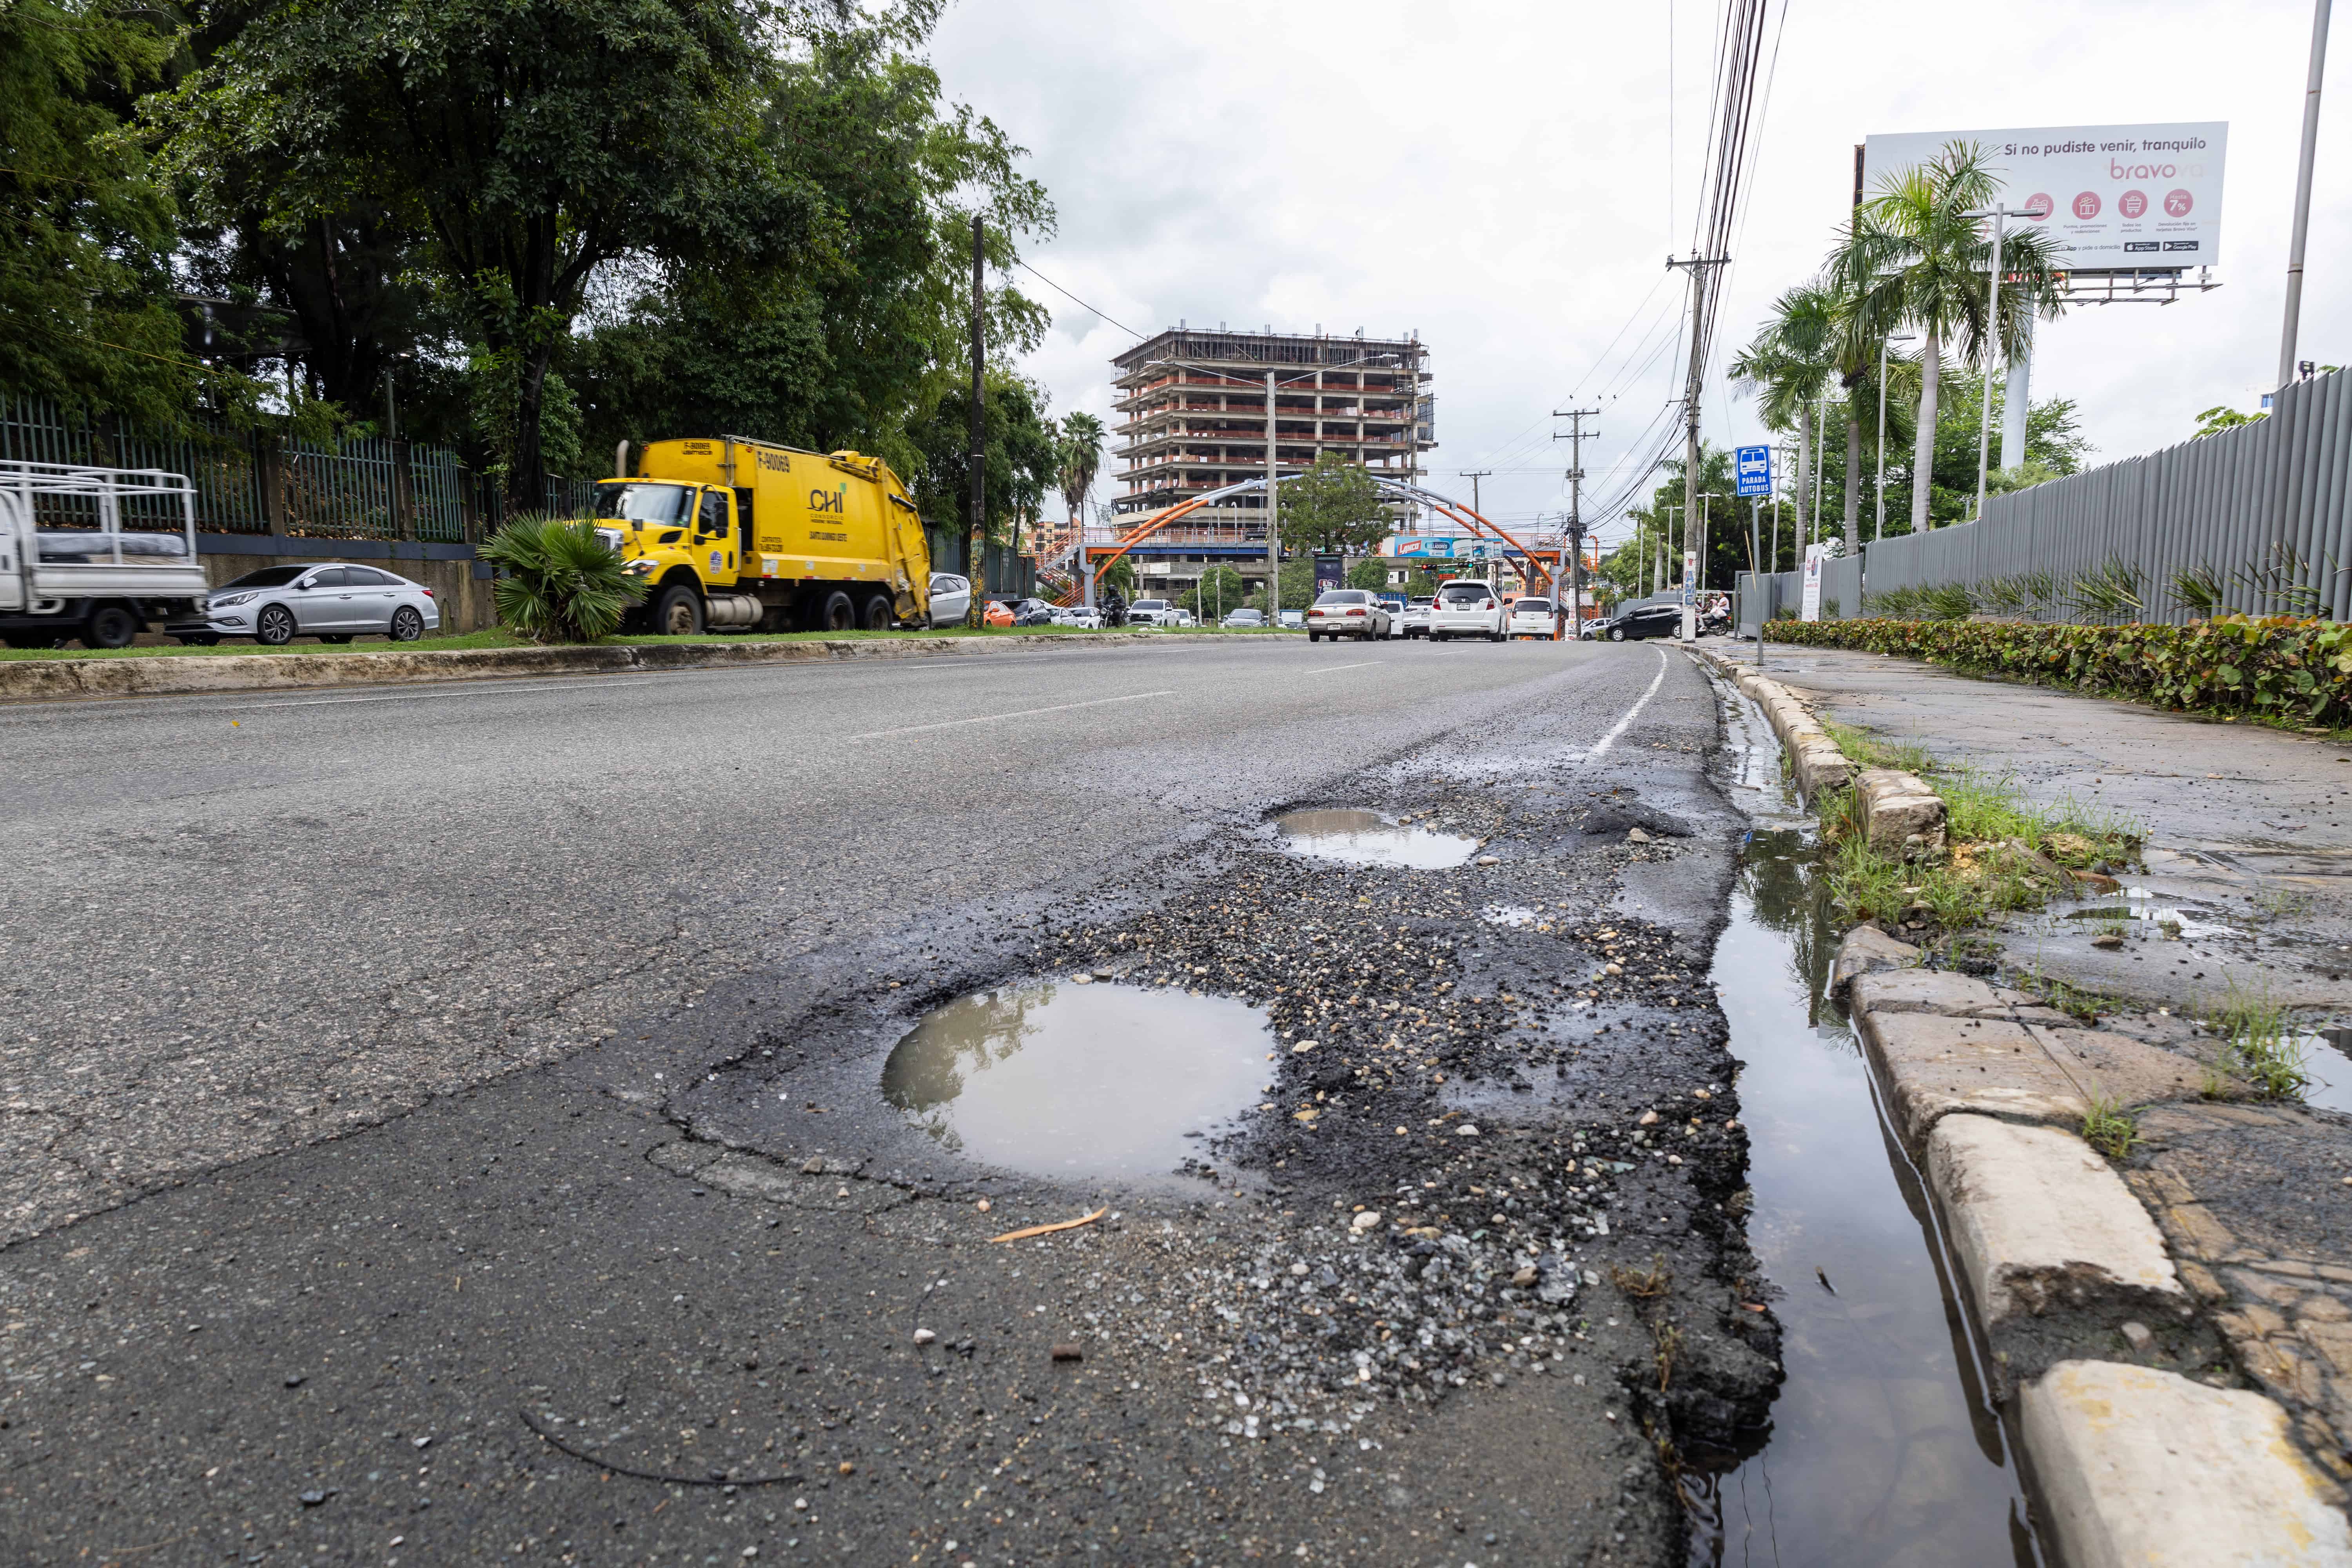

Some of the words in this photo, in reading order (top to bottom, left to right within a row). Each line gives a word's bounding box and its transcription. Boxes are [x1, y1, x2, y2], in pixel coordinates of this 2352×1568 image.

[2005, 143, 2016, 155] Si
[2022, 144, 2039, 155] no
[2044, 141, 2095, 157] pudiste
[2100, 140, 2137, 152] venir,
[2142, 137, 2206, 152] tranquilo
[2170, 200, 2186, 211] 7%
[1742, 476, 1766, 484] PARADA
[1740, 484, 1768, 493] AUTOBUS
[806, 489, 843, 513] CHI
[1399, 543, 1419, 554] LANCO
